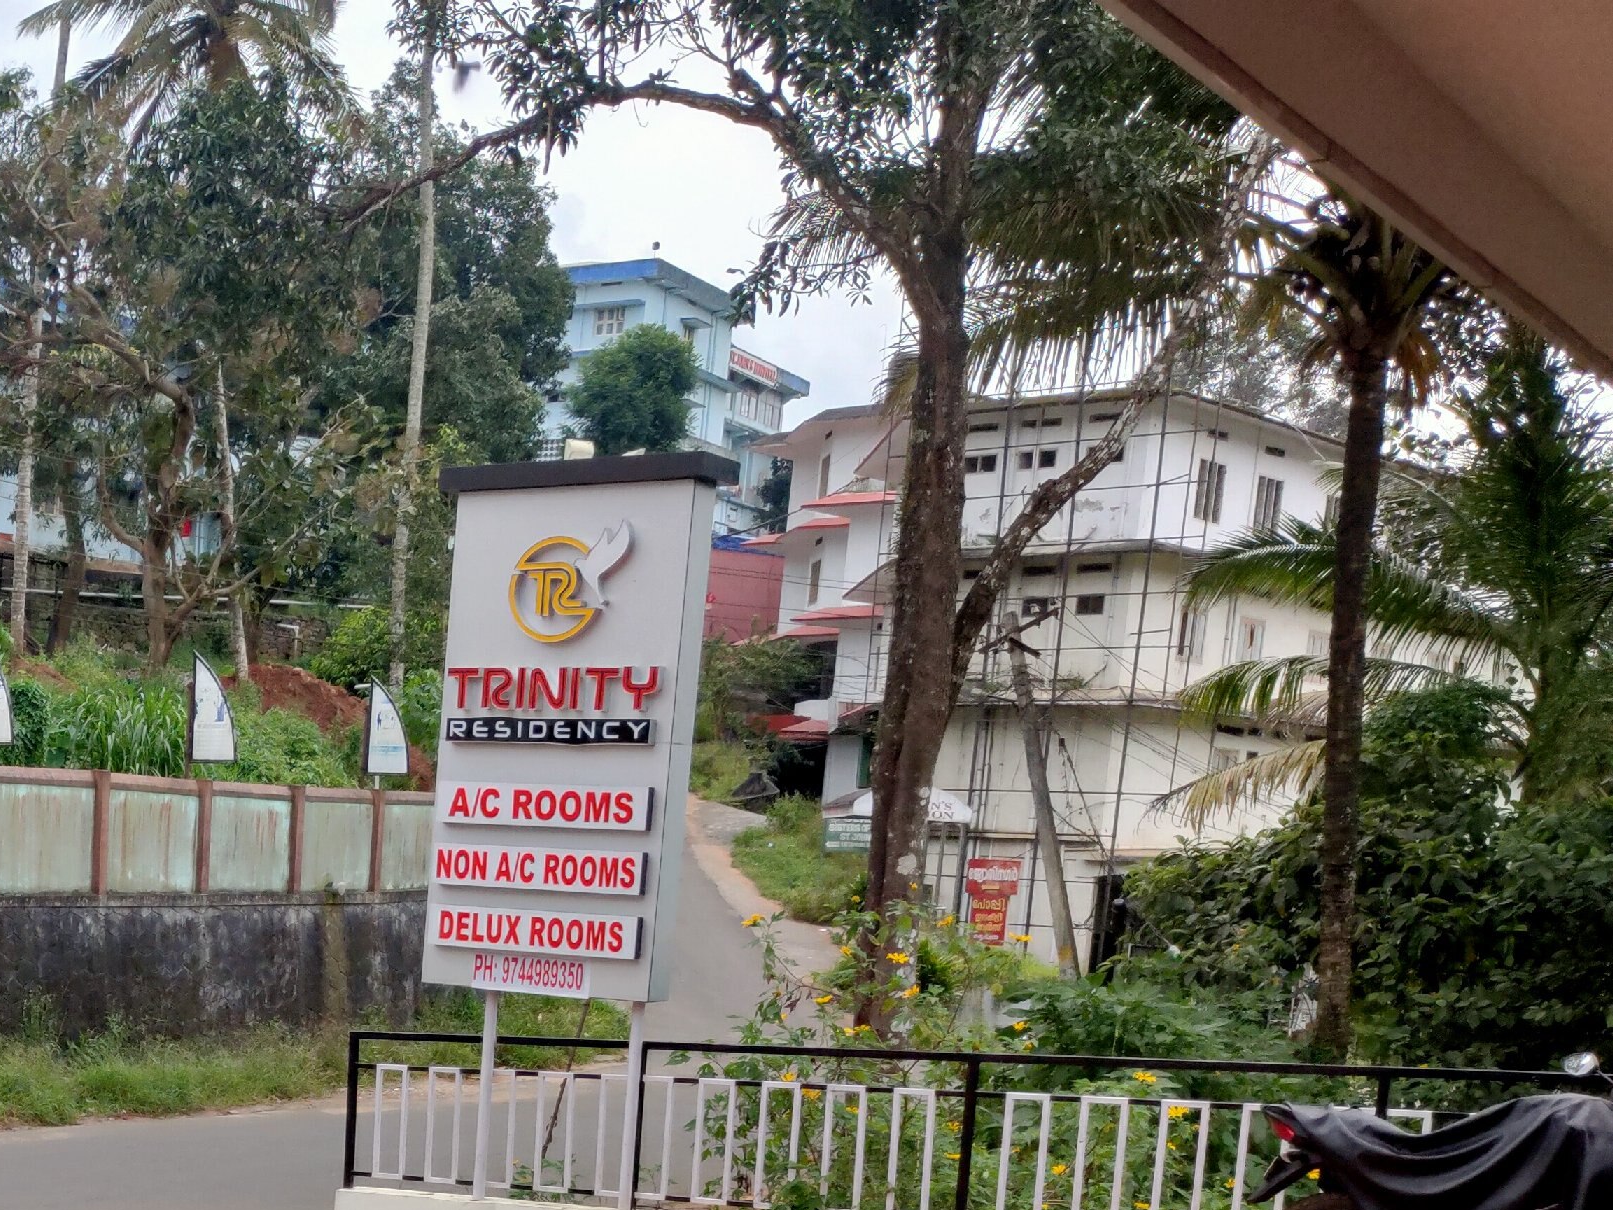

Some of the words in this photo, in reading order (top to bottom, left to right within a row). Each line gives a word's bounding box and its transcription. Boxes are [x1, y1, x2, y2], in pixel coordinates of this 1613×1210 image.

[448, 666, 660, 711] TRINITY
[449, 720, 648, 740] RESIDENCY
[448, 787, 500, 818] A/C
[512, 789, 634, 824] ROOMS
[436, 849, 488, 881] NON
[494, 852, 535, 883] A/C
[543, 854, 636, 889] ROOMS
[438, 909, 521, 945] DELUX
[529, 916, 623, 953] ROOMS
[473, 955, 497, 982] PH:
[502, 956, 584, 991] 9744989350
